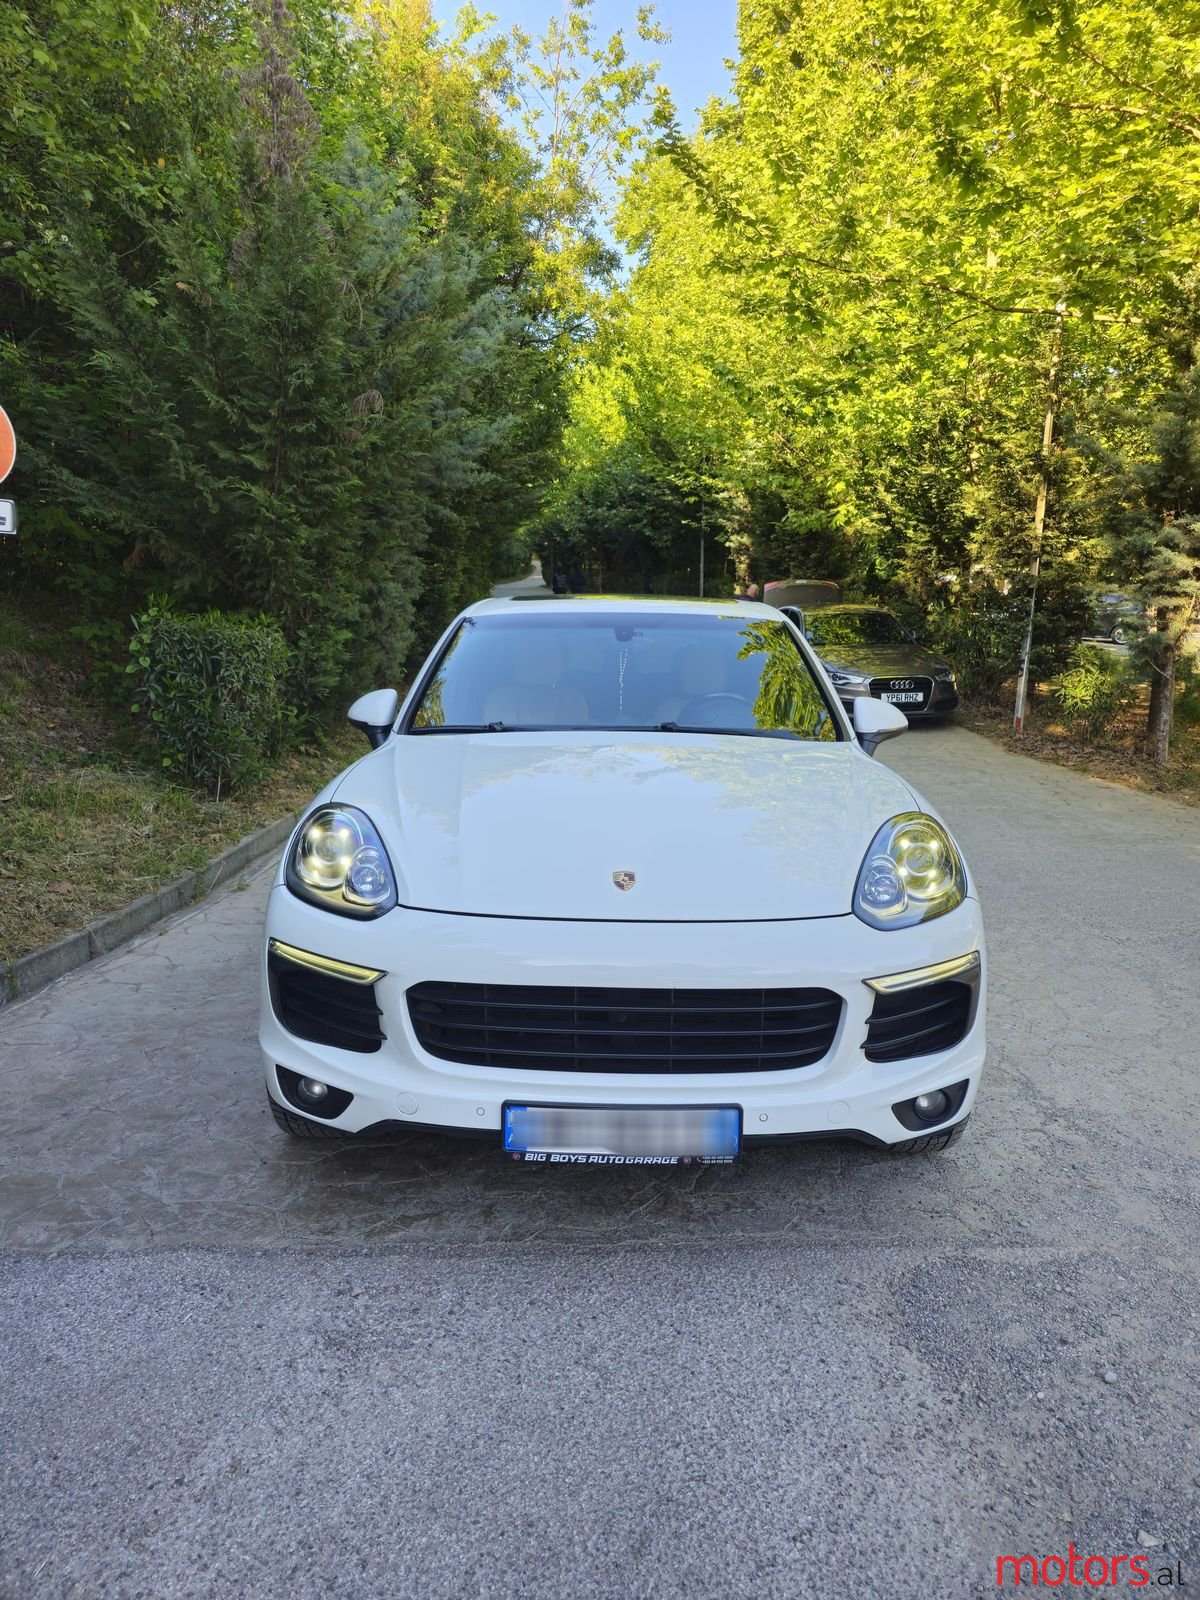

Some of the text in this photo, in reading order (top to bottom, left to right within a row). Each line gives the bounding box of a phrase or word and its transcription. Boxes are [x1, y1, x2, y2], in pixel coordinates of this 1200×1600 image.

[886, 693, 919, 702] YP61 RHZ
[524, 1153, 679, 1165] BIG BOYS AUTO GARAGE
